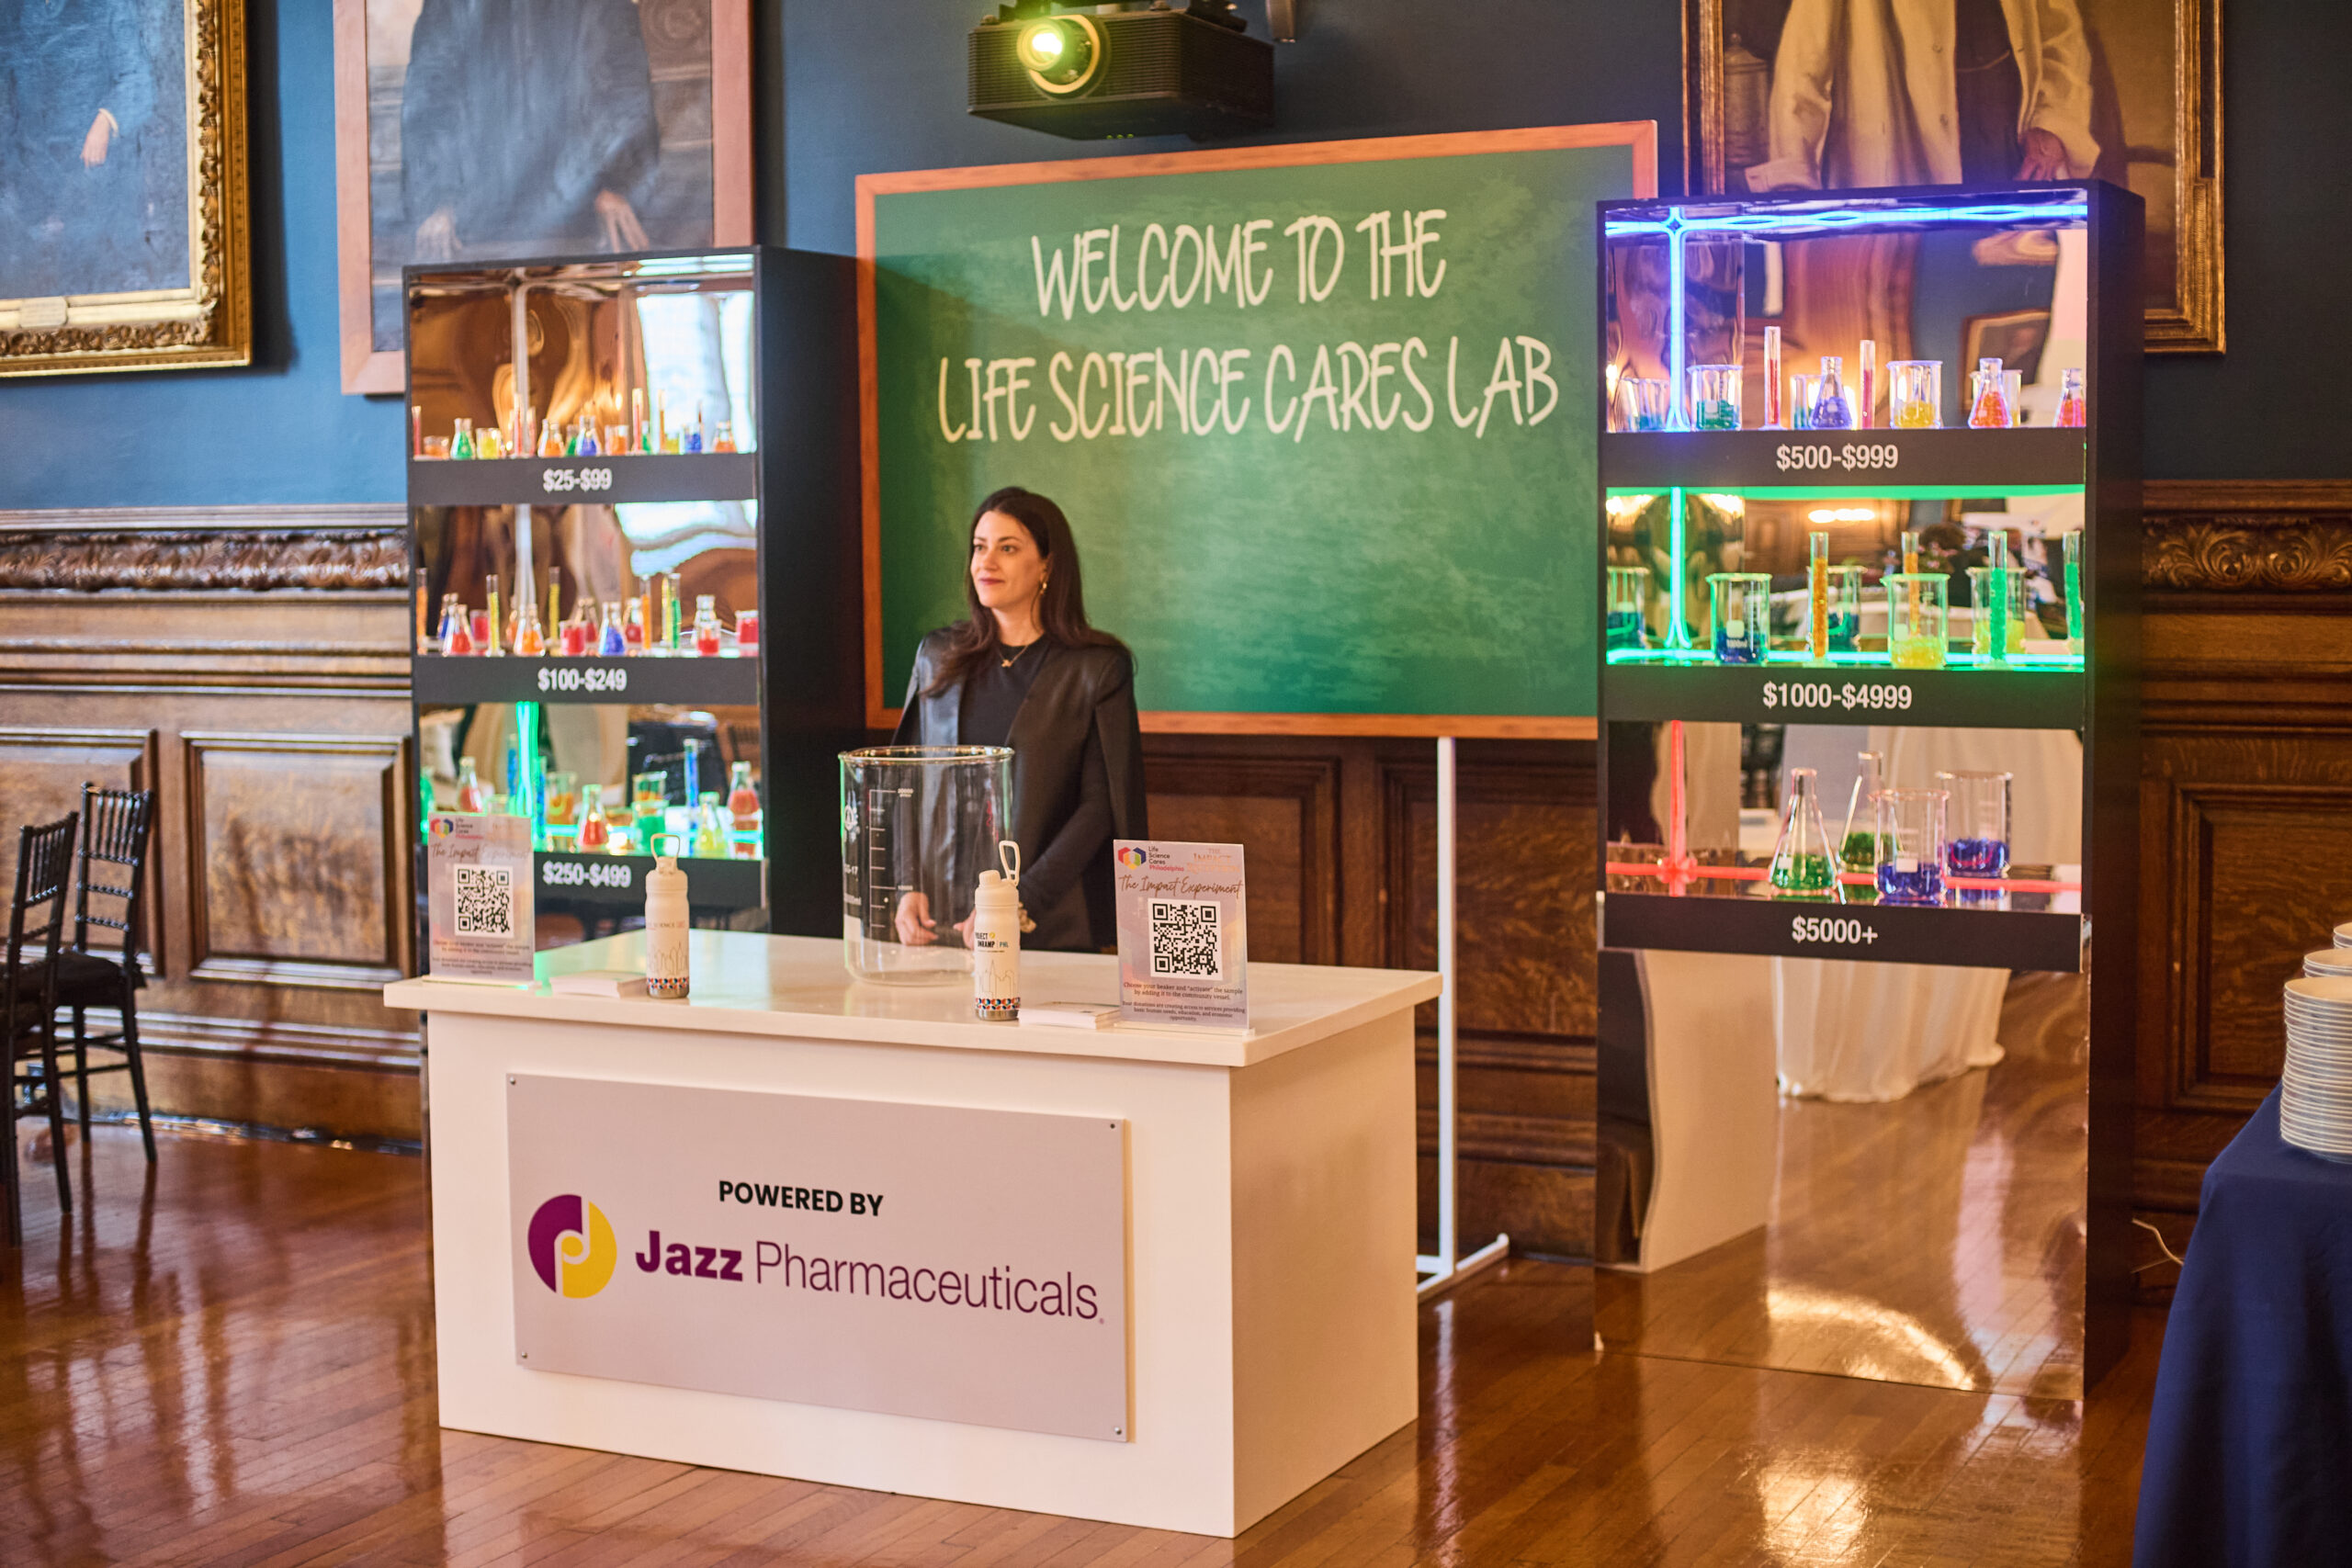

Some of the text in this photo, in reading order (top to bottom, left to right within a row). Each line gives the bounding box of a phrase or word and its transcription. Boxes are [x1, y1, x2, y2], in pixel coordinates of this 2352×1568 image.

[1031, 209, 1447, 321] WELCOME TO THE
[937, 334, 1560, 444] LIFE SCIENCE CARES LAB
[1775, 444, 1899, 472] $500-$999
[542, 467, 613, 493] $25-$99
[537, 668, 628, 693] $100-$249
[1762, 680, 1913, 710] $1000-$4999
[542, 862, 633, 888] $250-$499
[1148, 864, 1184, 873] Philadelphia
[1119, 874, 1243, 899] The Impact Experiment
[1792, 916, 1879, 946] $5000+
[1182, 992, 1213, 1000] community
[718, 1179, 884, 1217] POWERED BY
[636, 1230, 1099, 1321] Jazz Pharmaceuticals
